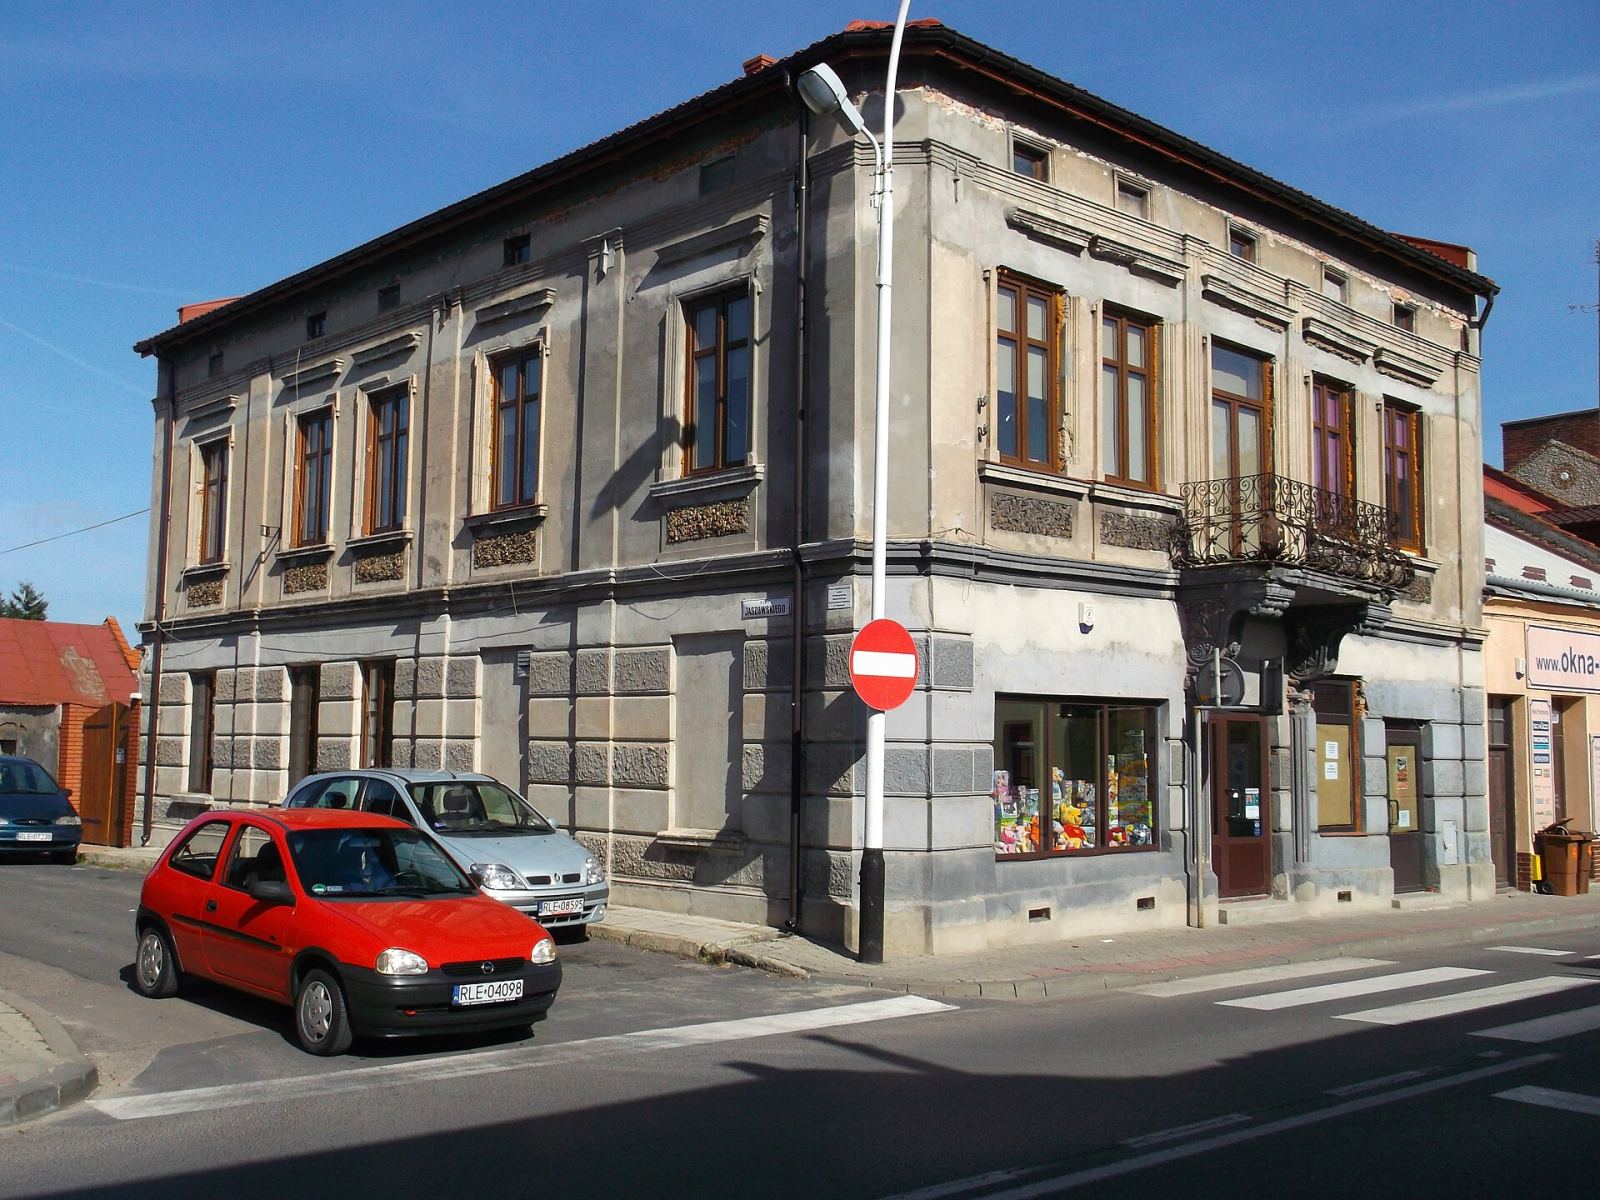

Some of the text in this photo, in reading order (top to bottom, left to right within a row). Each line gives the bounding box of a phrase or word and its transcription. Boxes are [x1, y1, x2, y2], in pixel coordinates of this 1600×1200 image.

[1536, 646, 1600, 675] www.okna-
[543, 901, 559, 913] RLE
[460, 984, 483, 1002] RLE
[487, 981, 522, 999] 04098
